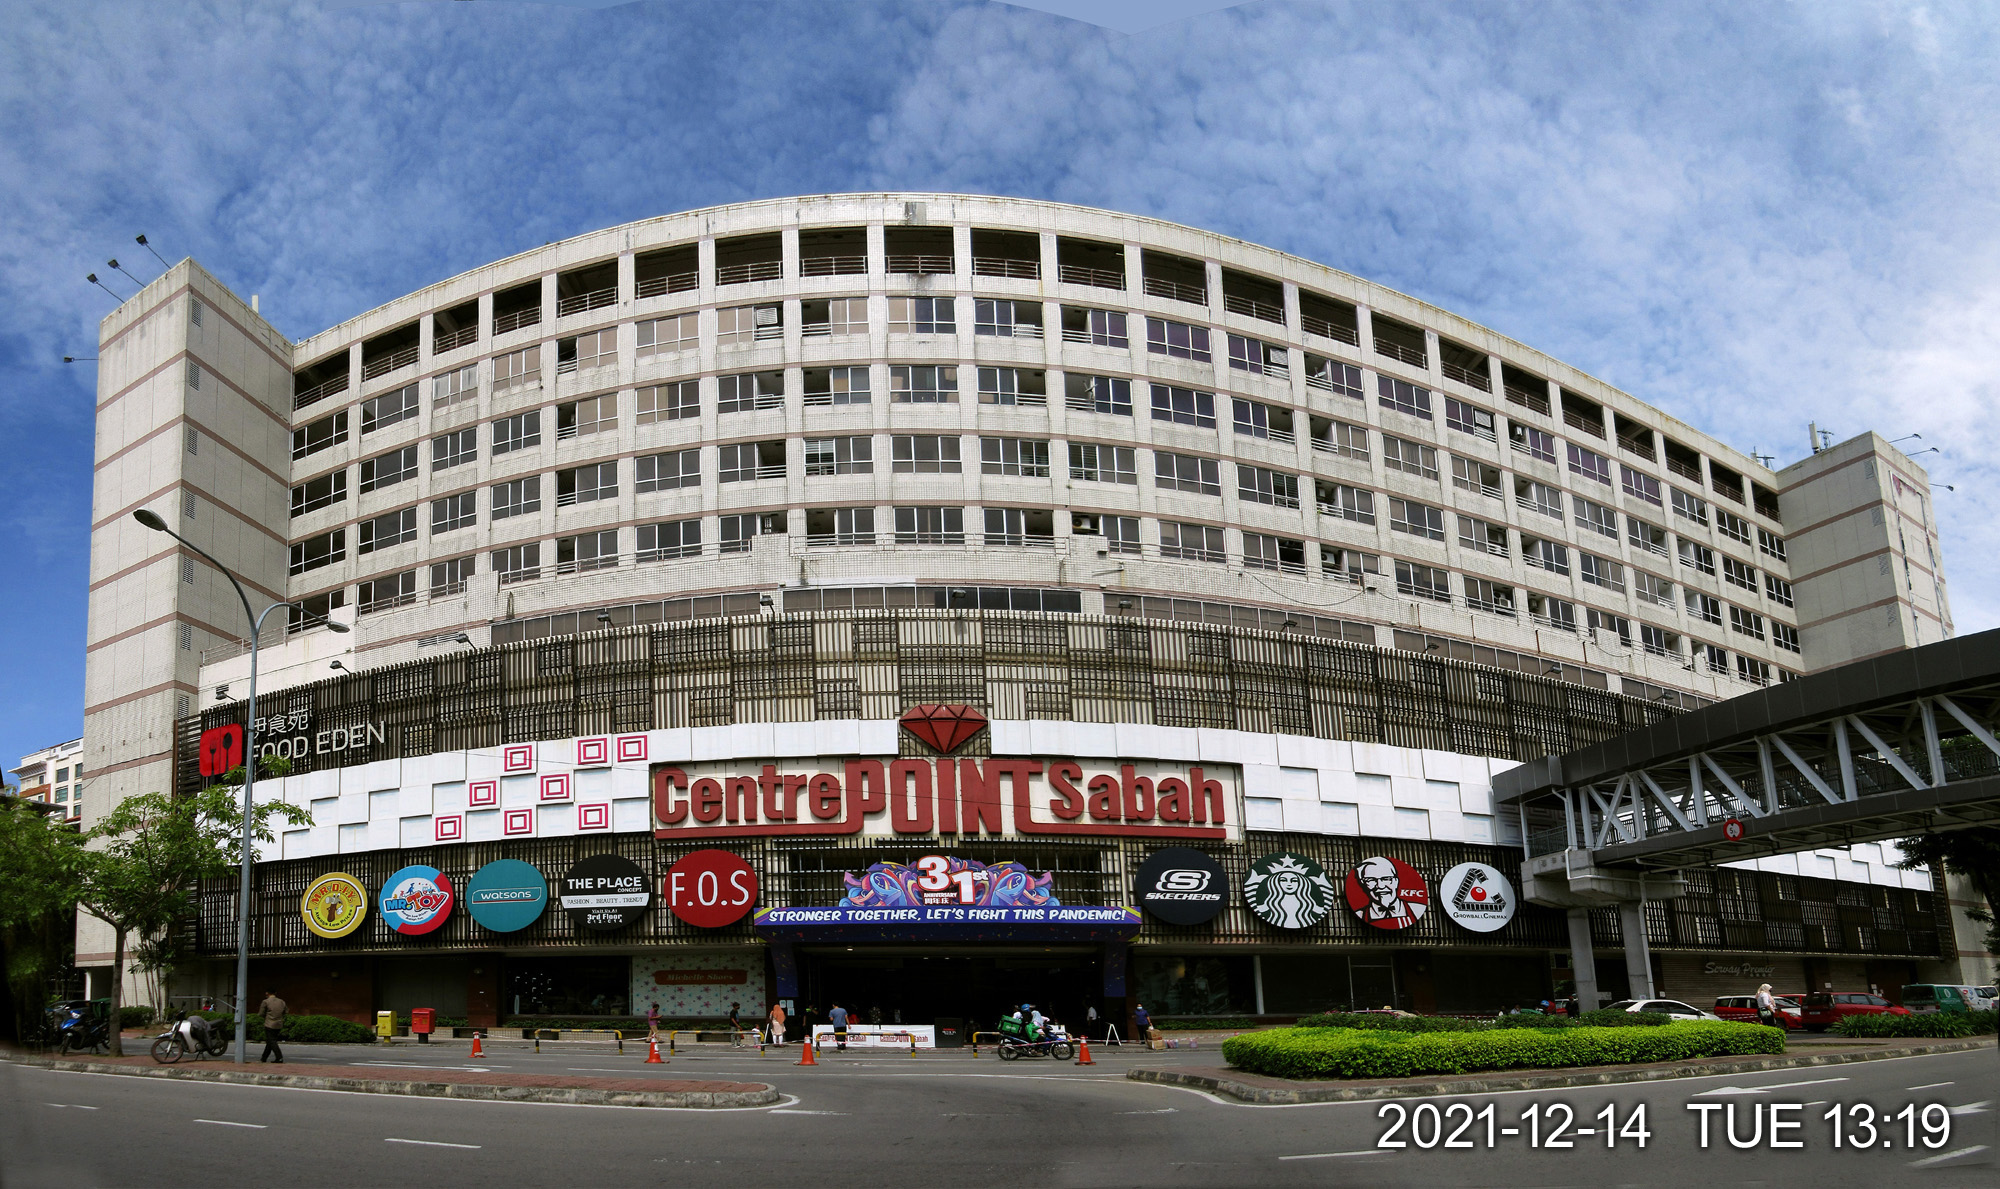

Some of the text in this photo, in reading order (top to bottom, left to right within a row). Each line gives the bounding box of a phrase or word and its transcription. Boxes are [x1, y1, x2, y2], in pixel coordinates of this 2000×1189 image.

[316, 720, 385, 755] EDEN
[1048, 760, 1226, 824] Sabah
[567, 876, 642, 890] THE PLACE
[671, 869, 750, 907] F.O.S
[480, 889, 532, 900] watsons
[1145, 893, 1221, 901] SKECHERS
[1400, 889, 1425, 898] KFC
[769, 908, 1127, 922] STRONGER TOGETHER, LET'S FIGHT THIS PANDEMIC!
[706, 973, 735, 981] Shoes
